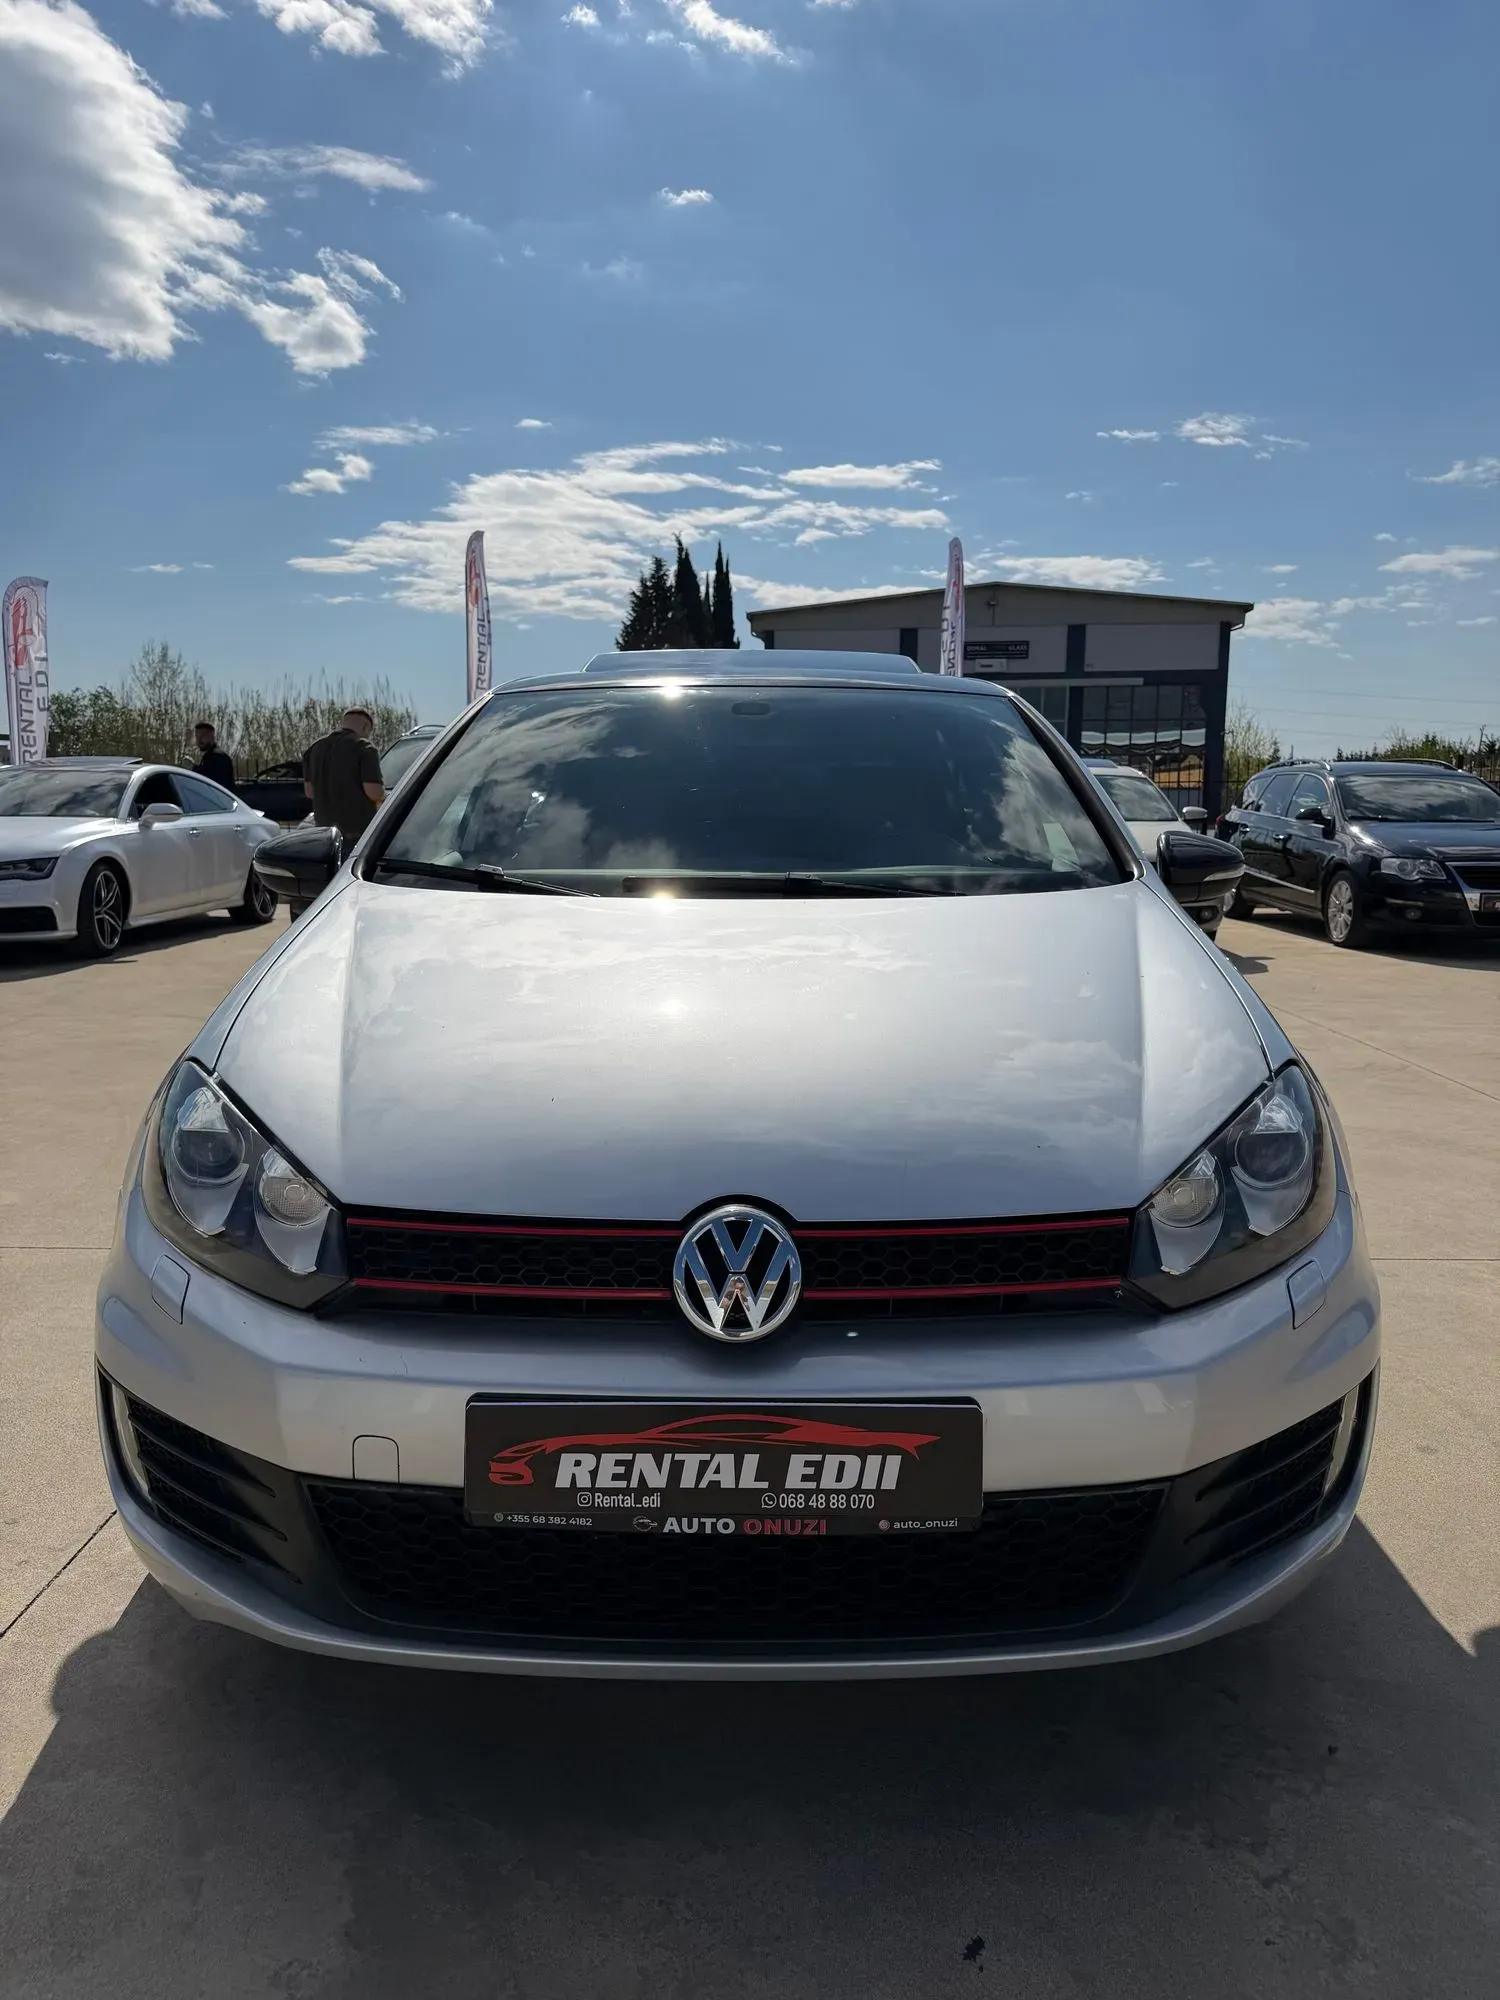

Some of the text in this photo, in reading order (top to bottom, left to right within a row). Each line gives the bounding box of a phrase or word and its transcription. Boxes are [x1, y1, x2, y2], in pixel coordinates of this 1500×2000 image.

[476, 613, 486, 691] RENTAL
[34, 656, 49, 712] EDI
[18, 676, 38, 764] RENTAL
[555, 1452, 902, 1489] RENTAL EDII
[594, 1492, 661, 1508] Rental_edi
[779, 1493, 875, 1509] 068 48 88 070
[506, 1514, 593, 1526] +355 68 382 4182
[663, 1517, 827, 1535] AUTO ONUZI
[893, 1518, 959, 1530] auto_onuzi
